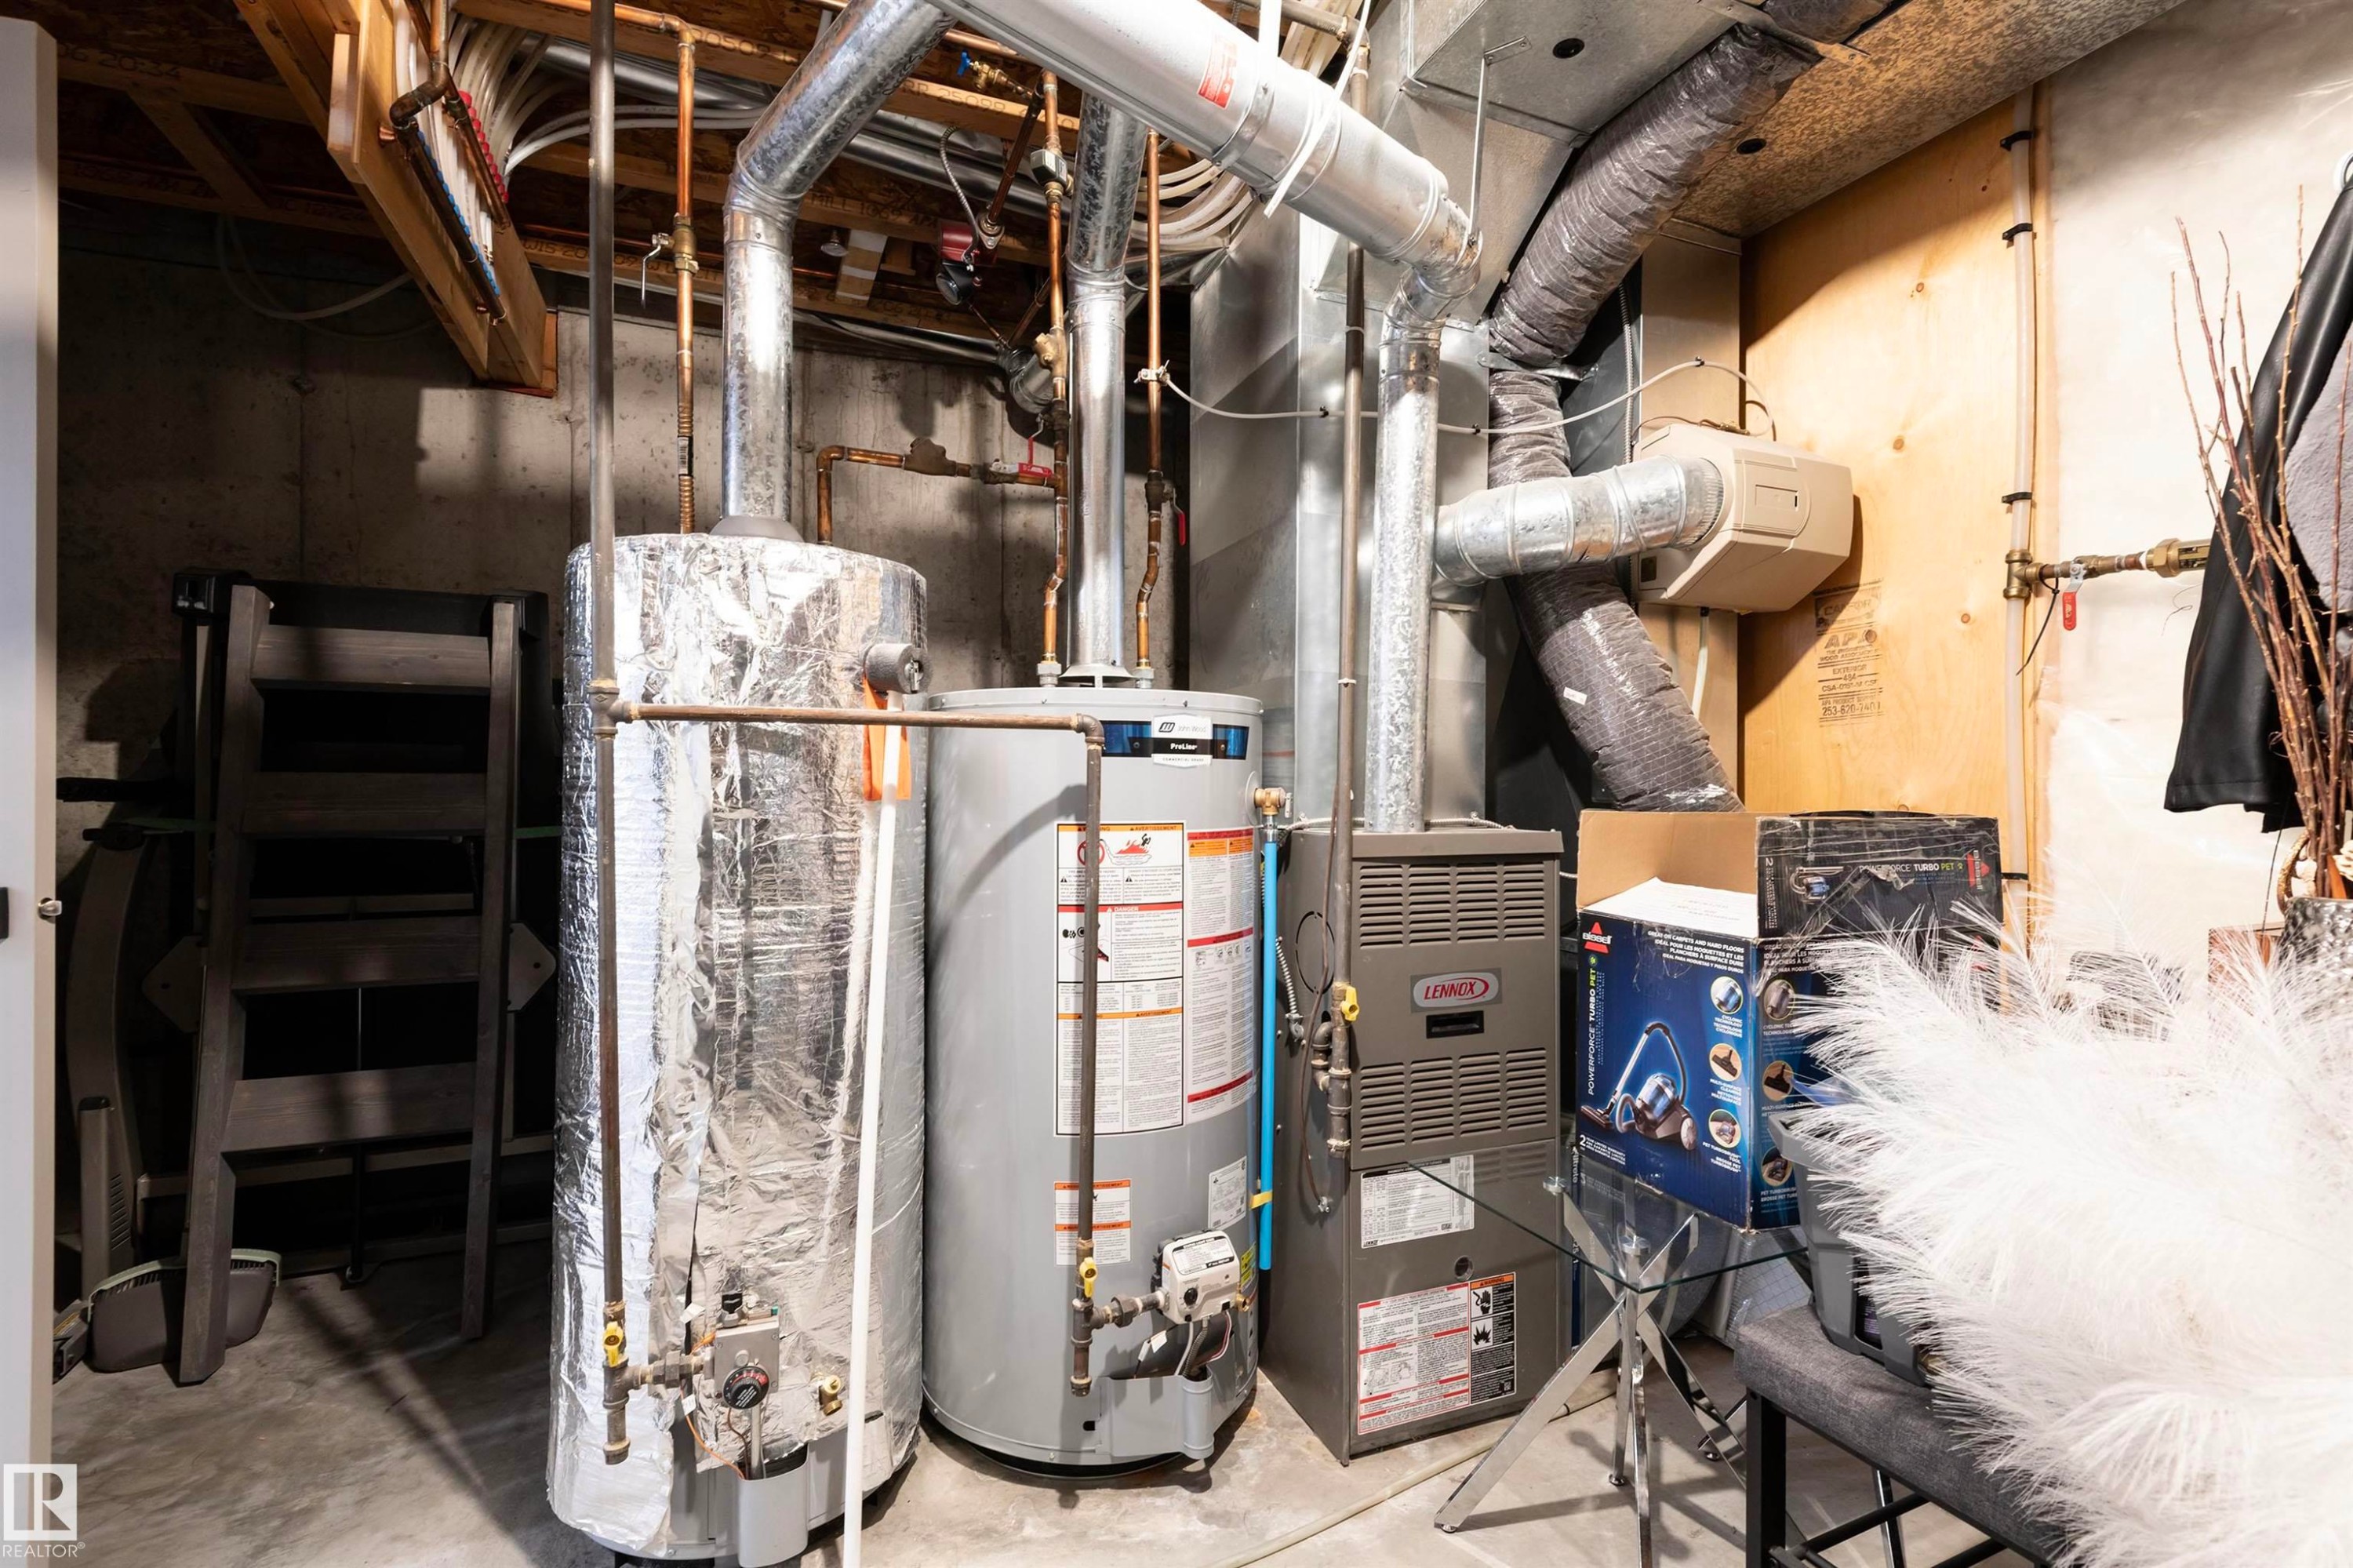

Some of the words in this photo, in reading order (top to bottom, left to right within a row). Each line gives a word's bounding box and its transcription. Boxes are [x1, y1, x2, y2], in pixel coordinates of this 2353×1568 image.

[1832, 664, 1867, 675] EXTERIOR
[1914, 863, 1940, 871] TURBO
[1672, 935, 1694, 944] CARPETS
[1722, 944, 1744, 954] FLOORS
[1694, 945, 1726, 958] MOQUETTES
[1734, 953, 1744, 962] LES
[1704, 954, 1729, 965] SURFACE
[1729, 958, 1744, 968] DURE
[1424, 981, 1476, 1000] LENNOX
[1579, 1134, 1587, 1147] 2
